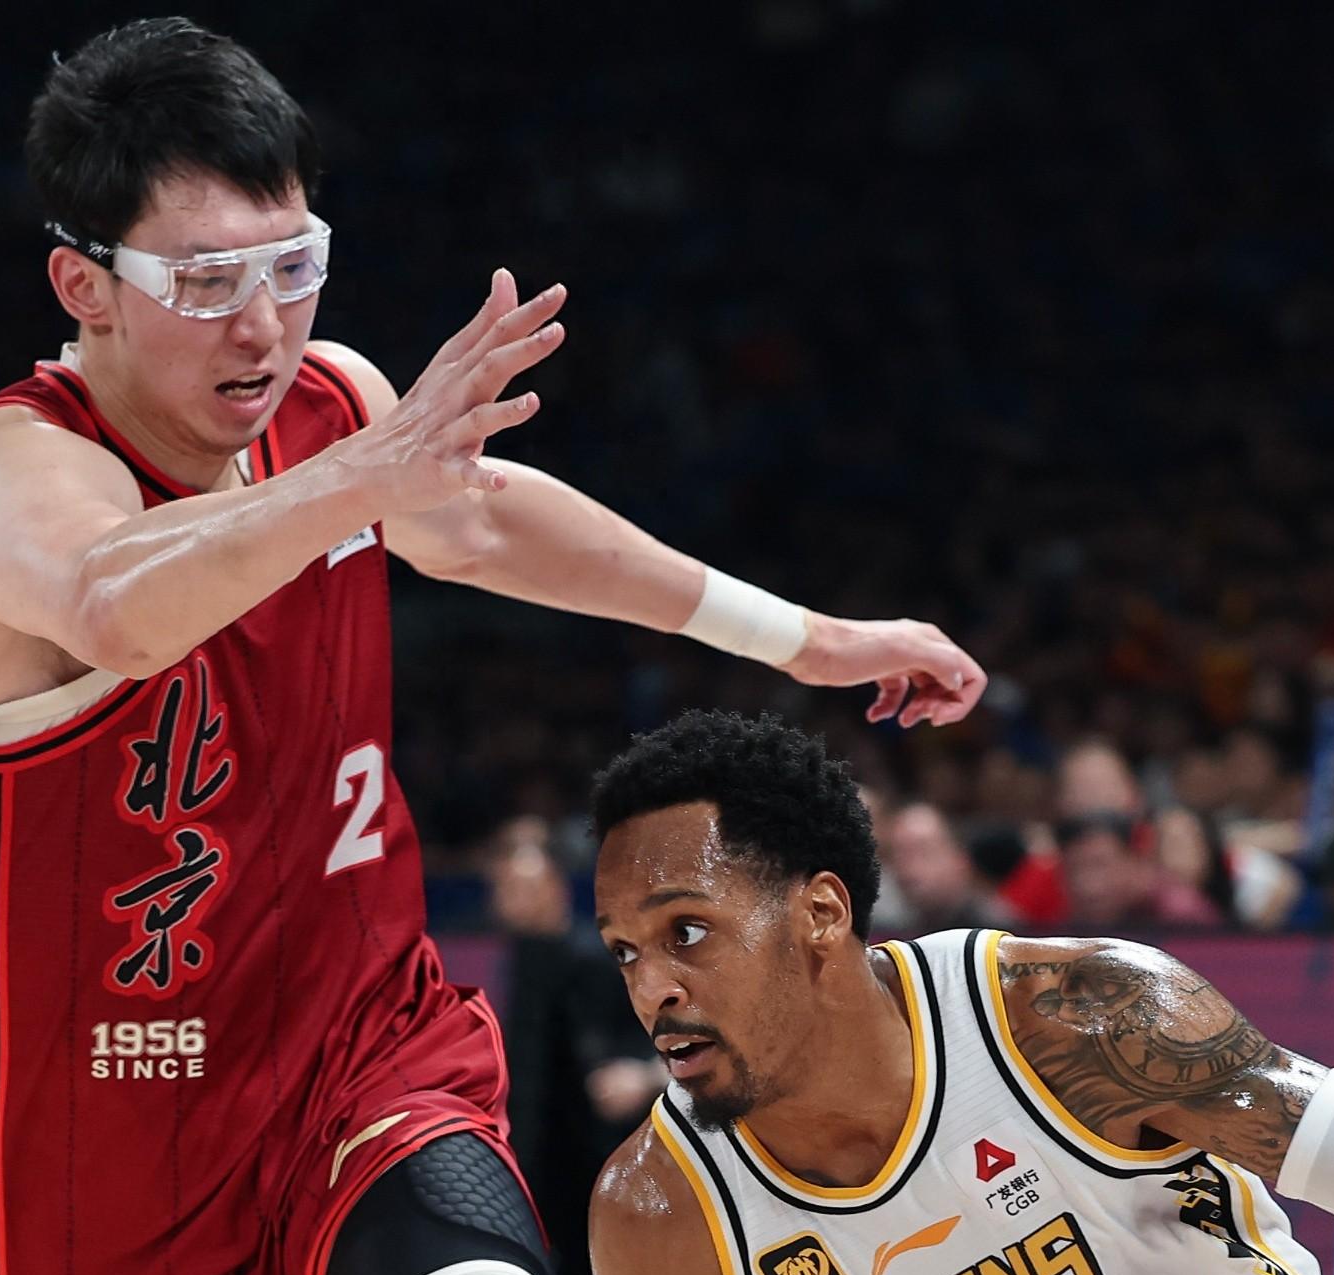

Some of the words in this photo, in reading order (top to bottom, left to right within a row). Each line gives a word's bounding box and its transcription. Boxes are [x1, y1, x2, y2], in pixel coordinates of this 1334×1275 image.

[114, 656, 231, 988] 北京
[324, 742, 384, 877] 2
[91, 1017, 206, 1057] 1956
[91, 1058, 205, 1079] SINCE
[985, 1169, 1040, 1209] 广发银行
[1005, 1189, 1040, 1216] CGB
